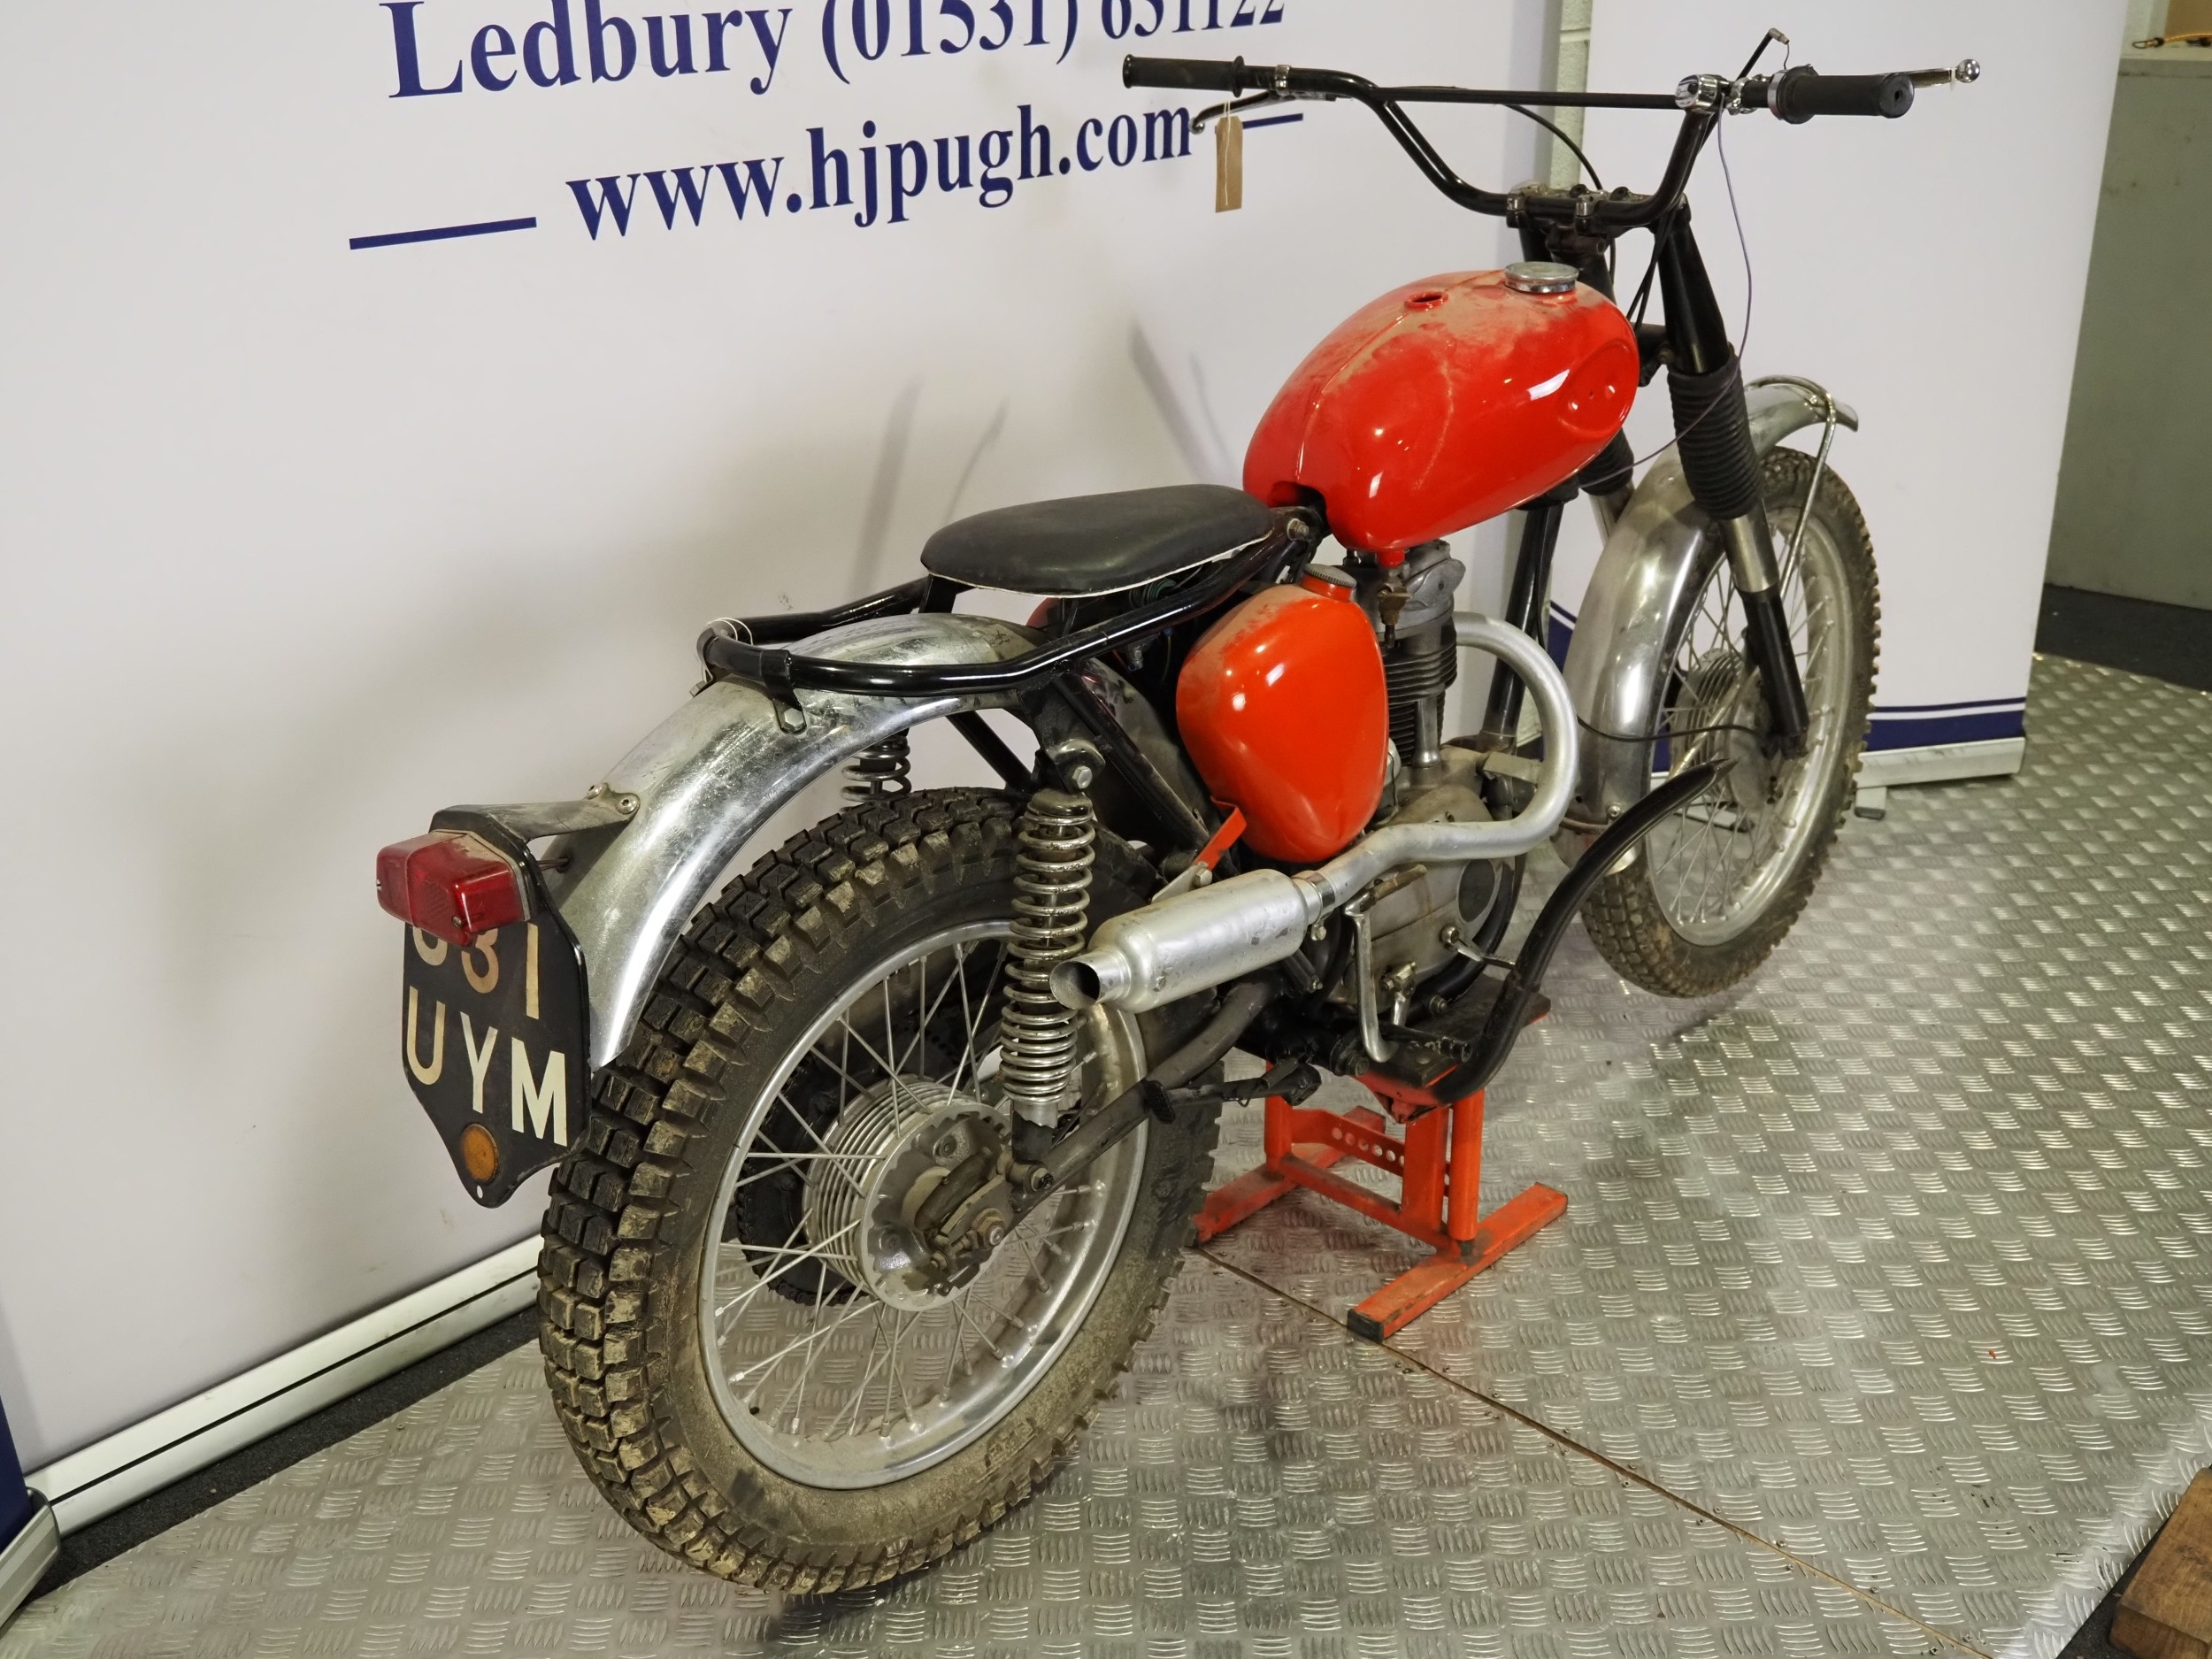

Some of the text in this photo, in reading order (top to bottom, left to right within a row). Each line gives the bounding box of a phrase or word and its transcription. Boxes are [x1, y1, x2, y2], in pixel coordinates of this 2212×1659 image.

[379, 0, 793, 98] Ledbury
[822, 0, 1078, 84] (01531)
[565, 104, 1191, 241] www.hjpugh.com
[407, 986, 568, 1147] UYM
